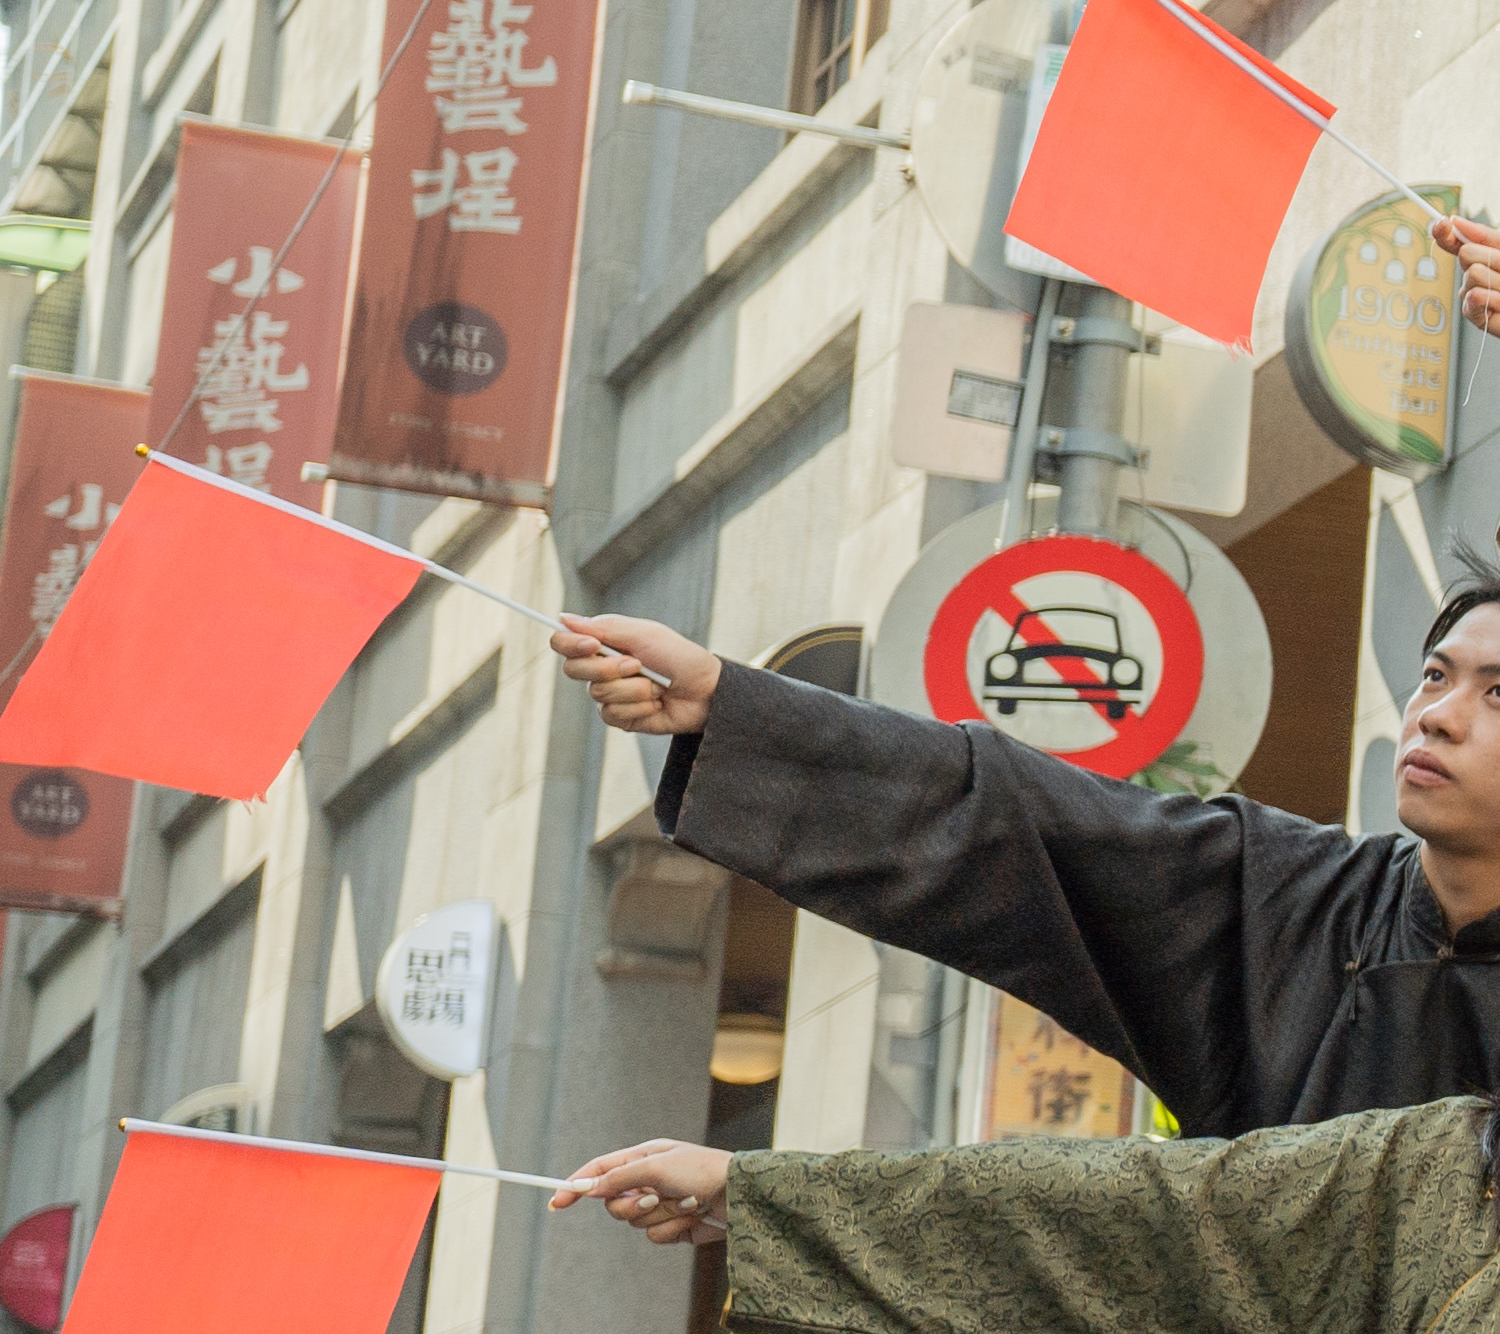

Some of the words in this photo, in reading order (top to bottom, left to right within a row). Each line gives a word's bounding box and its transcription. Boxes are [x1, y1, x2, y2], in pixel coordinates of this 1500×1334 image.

[1333, 283, 1447, 336] 1900
[430, 321, 488, 350] ART
[415, 341, 496, 377] YARD
